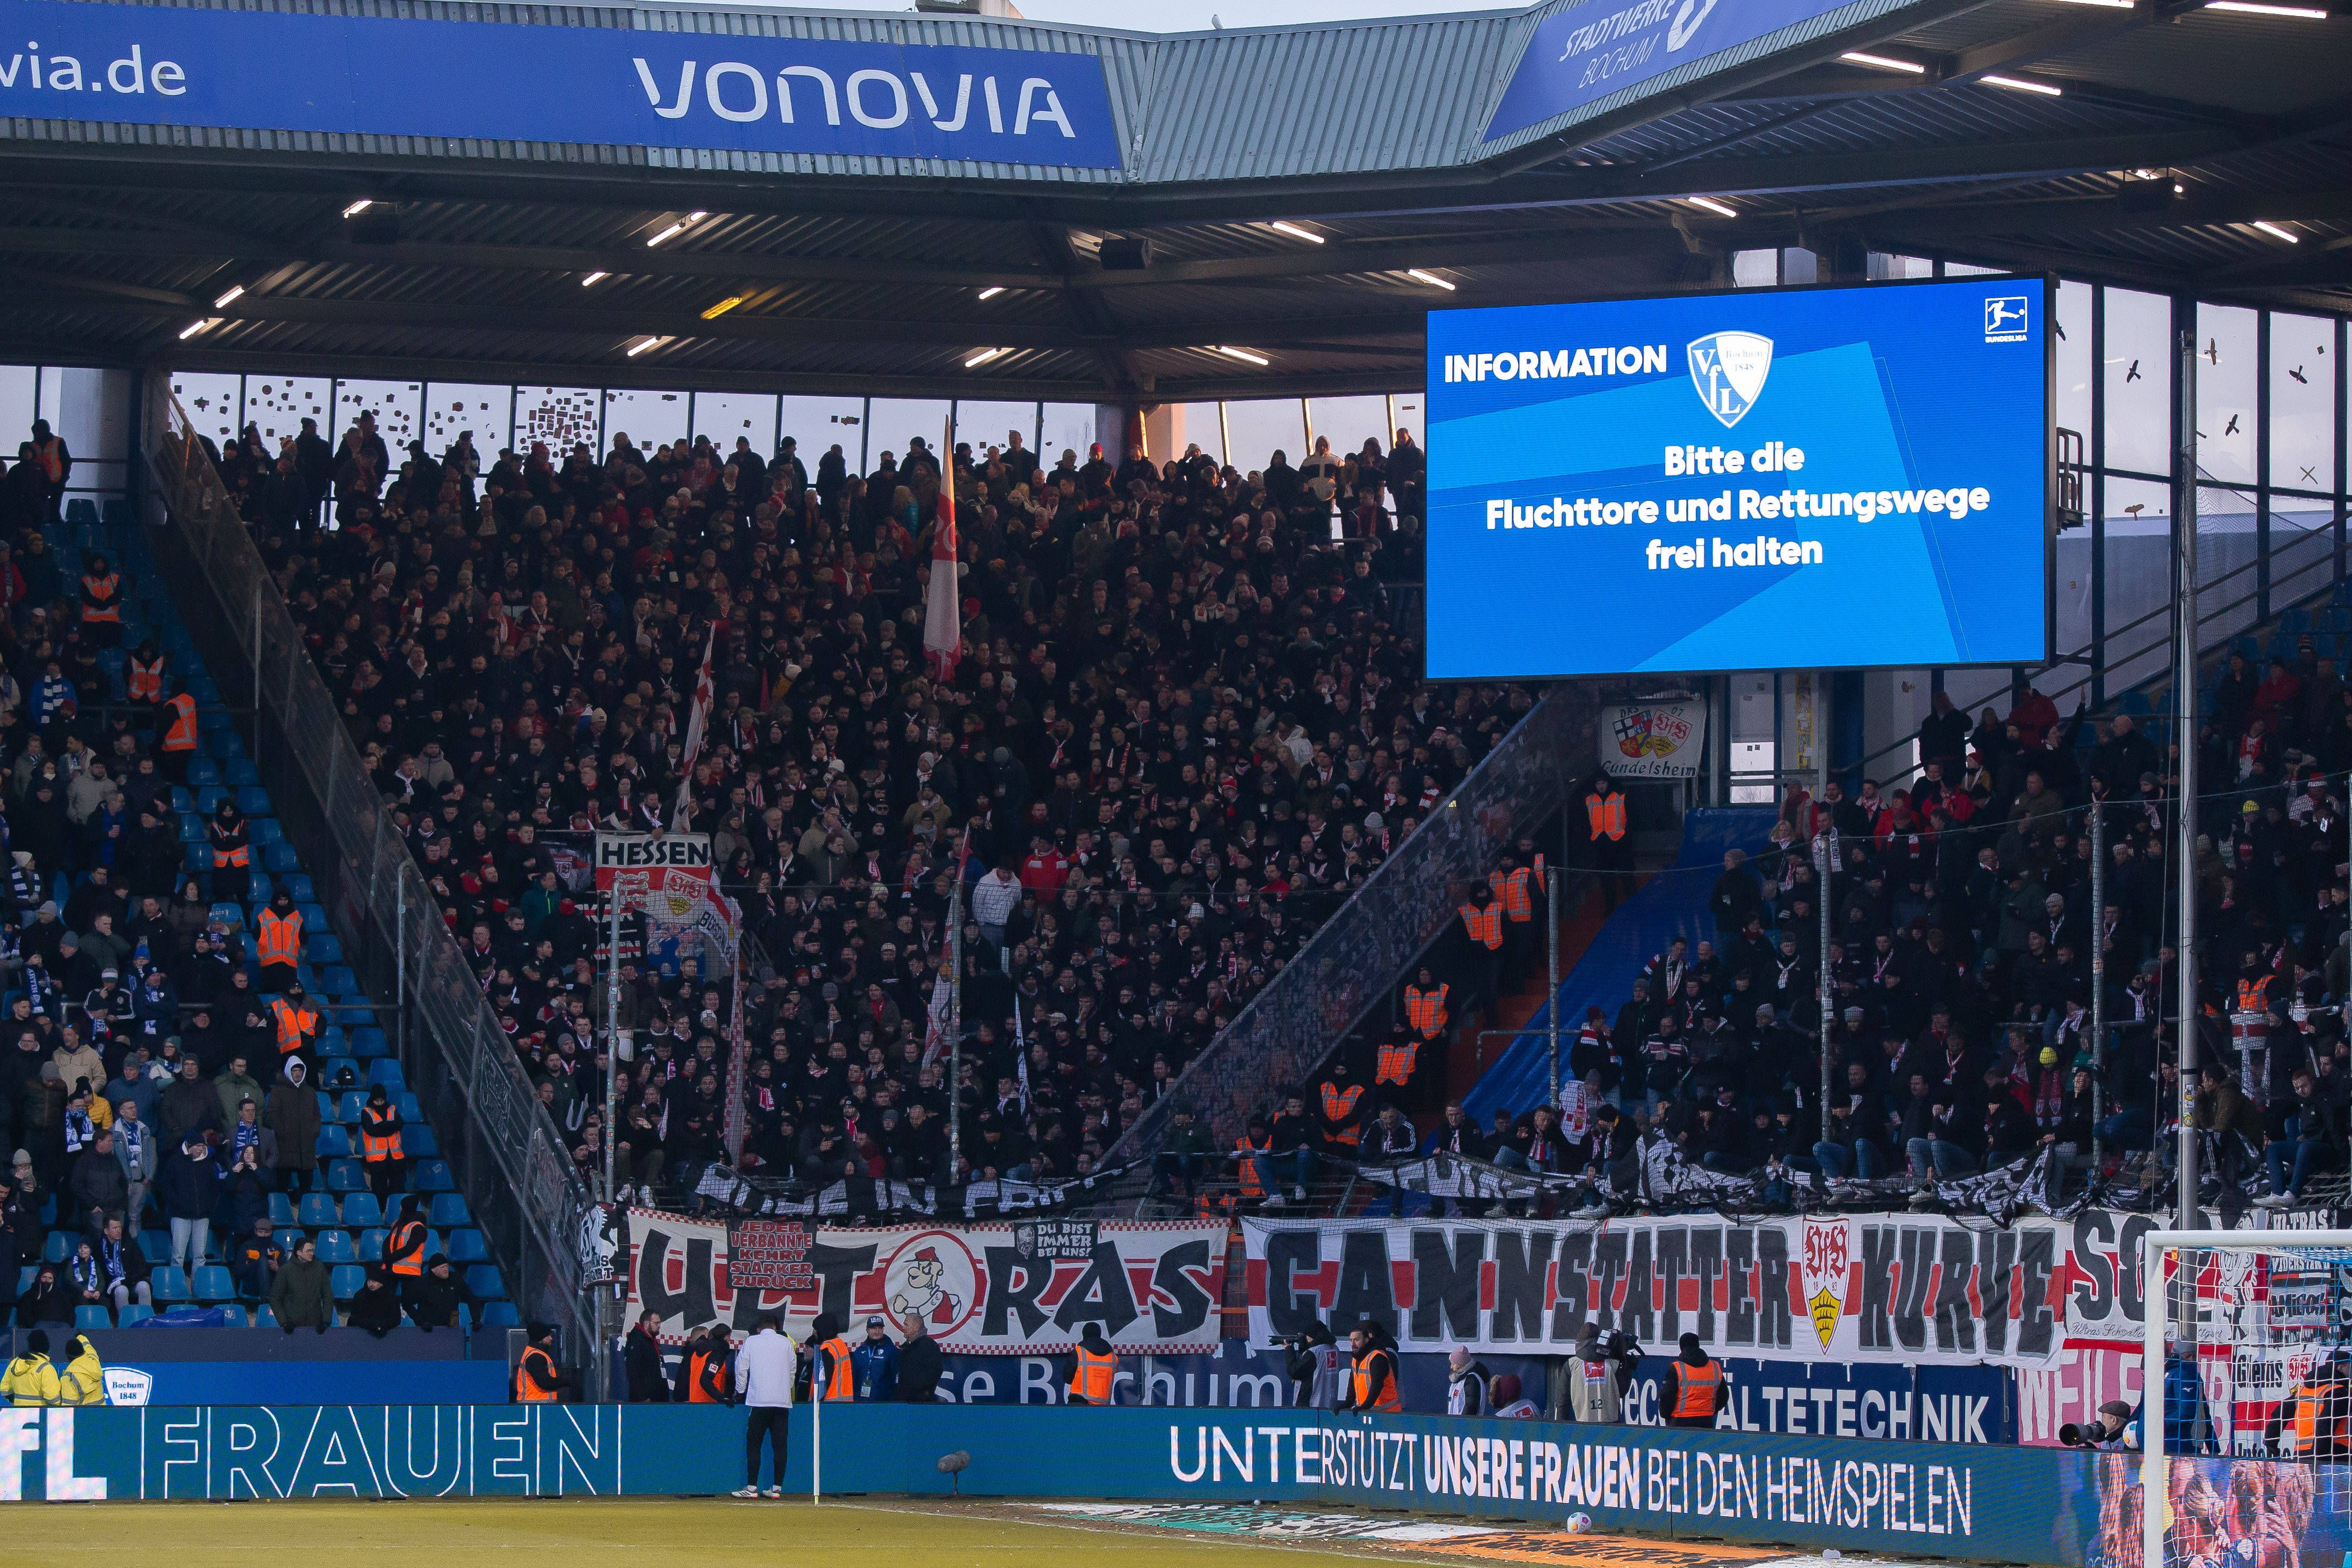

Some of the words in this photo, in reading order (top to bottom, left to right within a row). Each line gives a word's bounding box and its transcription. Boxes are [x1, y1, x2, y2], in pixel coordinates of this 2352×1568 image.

[1559, 0, 1677, 63] STADTWERKE
[1578, 33, 1660, 89] BOCHUM
[632, 57, 1076, 138] VONOVIA
[1444, 344, 1667, 382] INFORMATION
[1664, 445, 1745, 476] Bitte
[1751, 441, 1805, 472] die
[1487, 497, 1659, 530] Fluchttore
[1666, 490, 1732, 523] und
[1739, 487, 1991, 523] Rettungswege
[1646, 538, 1705, 570] frei
[1712, 536, 1823, 568] halten
[602, 840, 709, 866] HESSEN
[730, 1232, 813, 1249] VERBANNTE
[739, 1220, 804, 1234] JEDER
[1037, 1224, 1057, 1235] DU
[1062, 1223, 1091, 1235] BIST
[1037, 1235, 1091, 1248] IMMER
[739, 1249, 806, 1262] KEHRT
[1037, 1247, 1058, 1258] BEI
[1061, 1247, 1091, 1257] UNS!
[731, 1274, 813, 1289] ZURÜCK
[1264, 1225, 1792, 1349] CANNSTATTER
[1859, 1224, 2056, 1359] KURVE
[112, 1381, 145, 1390] Bochum
[118, 1392, 138, 1400] 1848
[1020, 1357, 1282, 1407] Bchum
[1590, 1399, 1604, 1410] 12
[1716, 1373, 1989, 1443] ÄLTETECHNIK
[141, 1405, 621, 1499] FRAUEN
[1170, 1417, 1418, 1491] UNTERSTÜTZT
[1424, 1435, 1524, 1499] UNSERE
[1530, 1441, 1640, 1510] FRAUEN
[1647, 1449, 1689, 1513] BEI
[1697, 1451, 1757, 1519] DEN
[1766, 1455, 1971, 1536] HEIMSPIELEN
